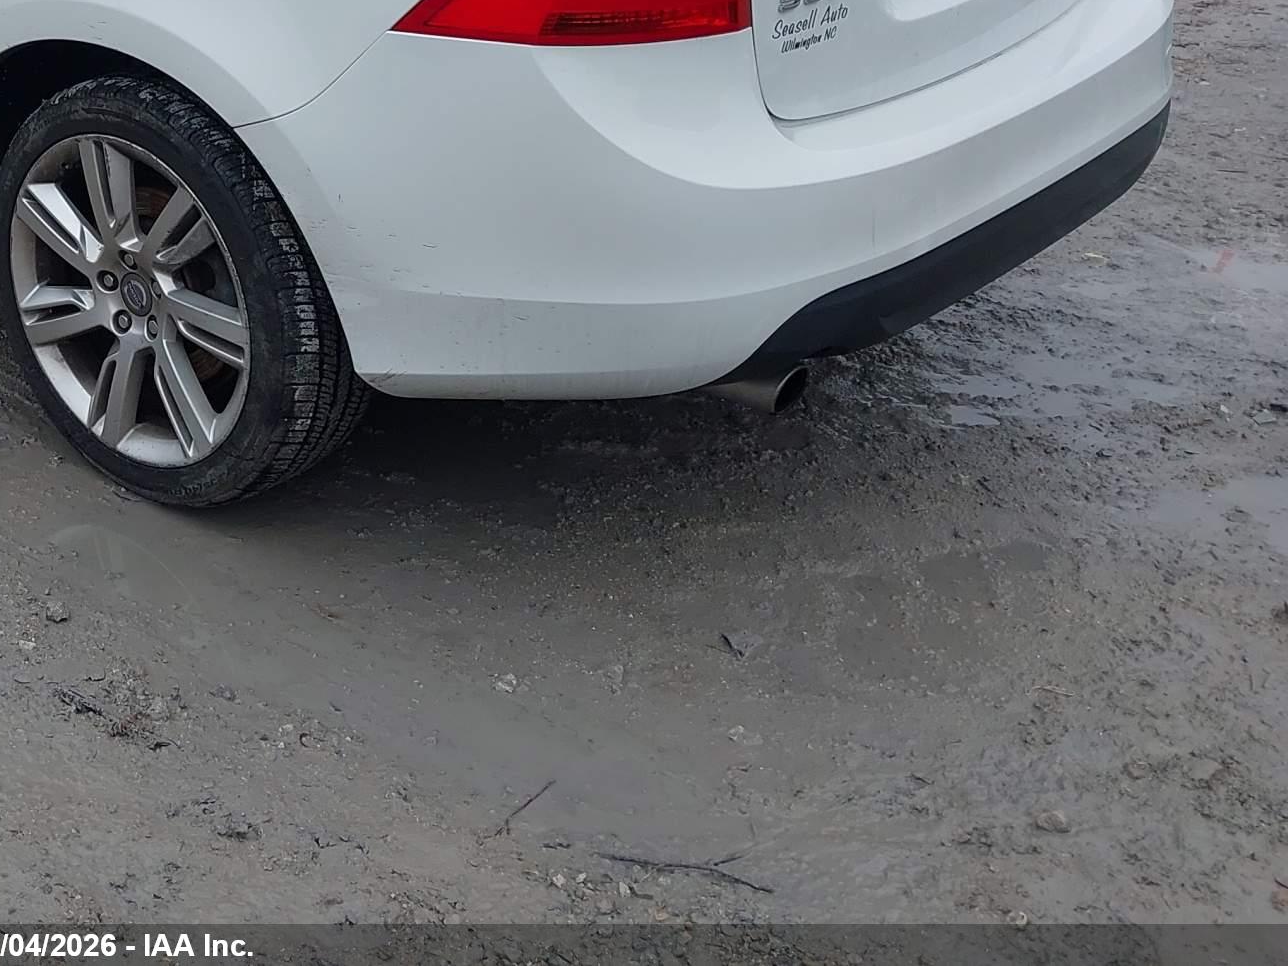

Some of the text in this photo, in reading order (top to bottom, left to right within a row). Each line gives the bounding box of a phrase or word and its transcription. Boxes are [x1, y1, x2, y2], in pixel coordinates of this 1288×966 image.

[772, 3, 848, 39] Seasell Auto
[824, 25, 837, 41] NC
